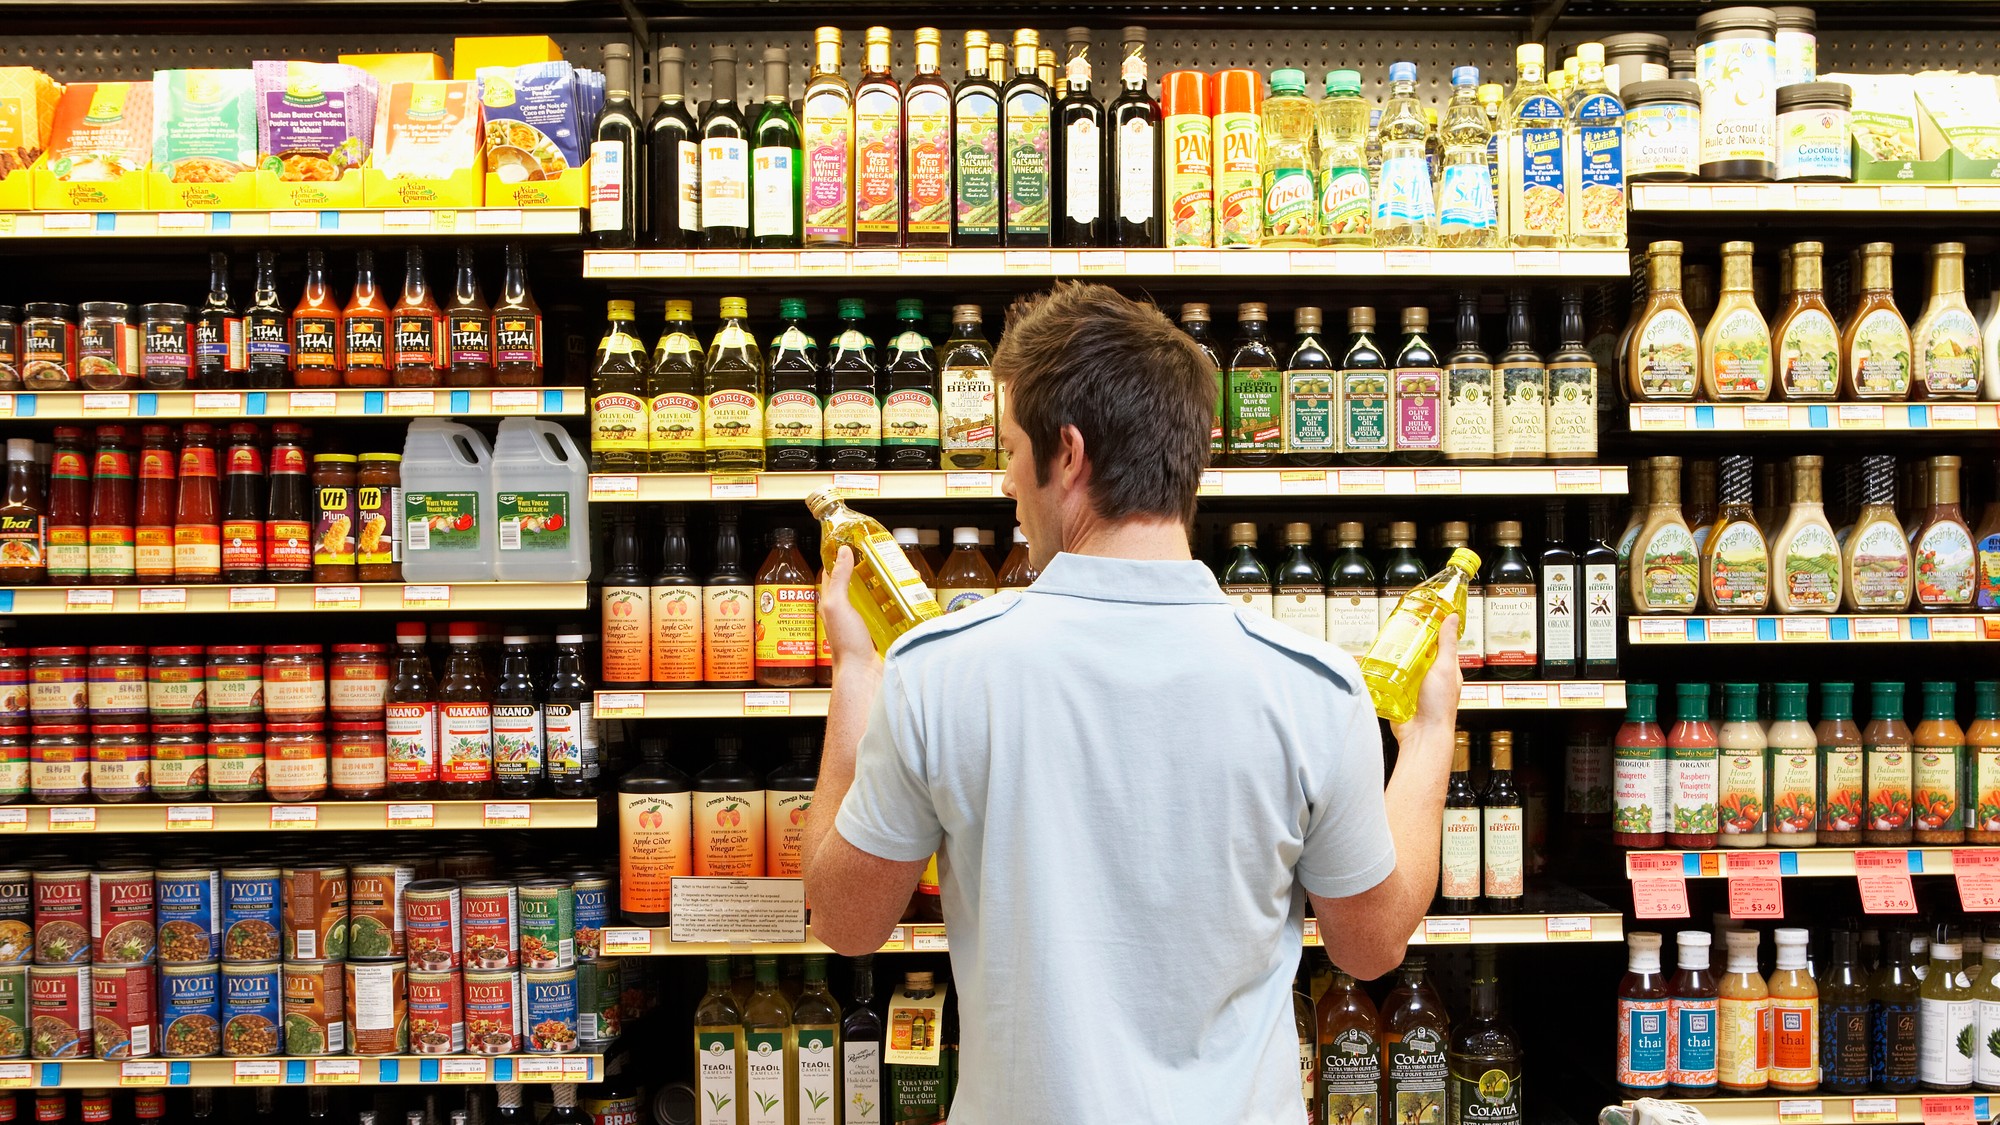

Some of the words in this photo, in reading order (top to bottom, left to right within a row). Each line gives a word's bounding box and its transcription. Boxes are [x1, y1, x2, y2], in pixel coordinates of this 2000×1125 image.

[1716, 123, 1758, 135] Coconut
[1705, 138, 1723, 148] Huile
[1726, 137, 1735, 145] de
[1739, 135, 1756, 144] Noix
[1759, 135, 1766, 144] de
[866, 151, 891, 159] Organic
[916, 151, 941, 159] Organic
[1176, 135, 1212, 164] PAM
[1799, 145, 1838, 155] Coconut
[815, 152, 840, 162] Organic
[870, 157, 887, 165] RED
[920, 158, 938, 166] RED
[960, 158, 993, 166] BALSAMIC
[1012, 158, 1044, 166] BALSAMIC
[813, 161, 840, 169] WHITE
[1013, 166, 1043, 174] VINEGAR
[1181, 191, 1210, 204] ORIGINAL
[1228, 188, 1259, 203] ORIGINAL
[1268, 183, 1310, 215] Crisco
[1324, 181, 1366, 214] Crisco
[254, 327, 284, 338] THAI
[147, 334, 182, 347] THAI
[298, 334, 332, 347] THAI
[347, 334, 381, 347] THAI
[395, 333, 429, 346] THAI
[599, 398, 636, 409] BORGES
[656, 398, 693, 408] BORGES
[713, 394, 750, 404] BORGES
[777, 394, 812, 404] BORGES
[836, 394, 870, 404] BORGES
[1474, 416, 1487, 424] Oil
[1573, 416, 1586, 424] Oil
[323, 511, 346, 521] Plum
[360, 512, 379, 520] Plum
[2, 517, 32, 528] Thai
[1651, 528, 1693, 555] OrganicVille
[1719, 528, 1761, 553] OrganicVille
[1790, 528, 1831, 553] OrganicVille
[1859, 528, 1902, 552] OrganicVille
[1923, 527, 1969, 552] OrganicVille
[1496, 586, 1527, 595] Spectrum
[1491, 602, 1518, 610] Peanut
[1520, 602, 1532, 610] Oil
[450, 708, 488, 716] NAKANO
[1681, 773, 1710, 781] Raspberry
[1730, 769, 1752, 777] Honey
[1727, 785, 1755, 794] Dressing
[706, 797, 724, 807] Omega
[726, 795, 750, 807] Nutrition
[1683, 792, 1708, 800] Dressing
[629, 798, 646, 809] Omega
[648, 797, 673, 809] Nutrition
[711, 836, 728, 844] Apple
[230, 883, 272, 898] JYOTi
[407, 904, 440, 917] JYOTi
[465, 901, 499, 914] JYOTi
[171, 978, 214, 993] JYOTi
[469, 985, 503, 999] JYOTi
[1639, 1037, 1661, 1048] thai
[1688, 1036, 1710, 1047] thai
[1781, 1034, 1805, 1045] thai
[1326, 1055, 1378, 1066] COLAVITA
[1394, 1054, 1446, 1065] COLAVITA
[1469, 1106, 1517, 1116] COLAVITA
